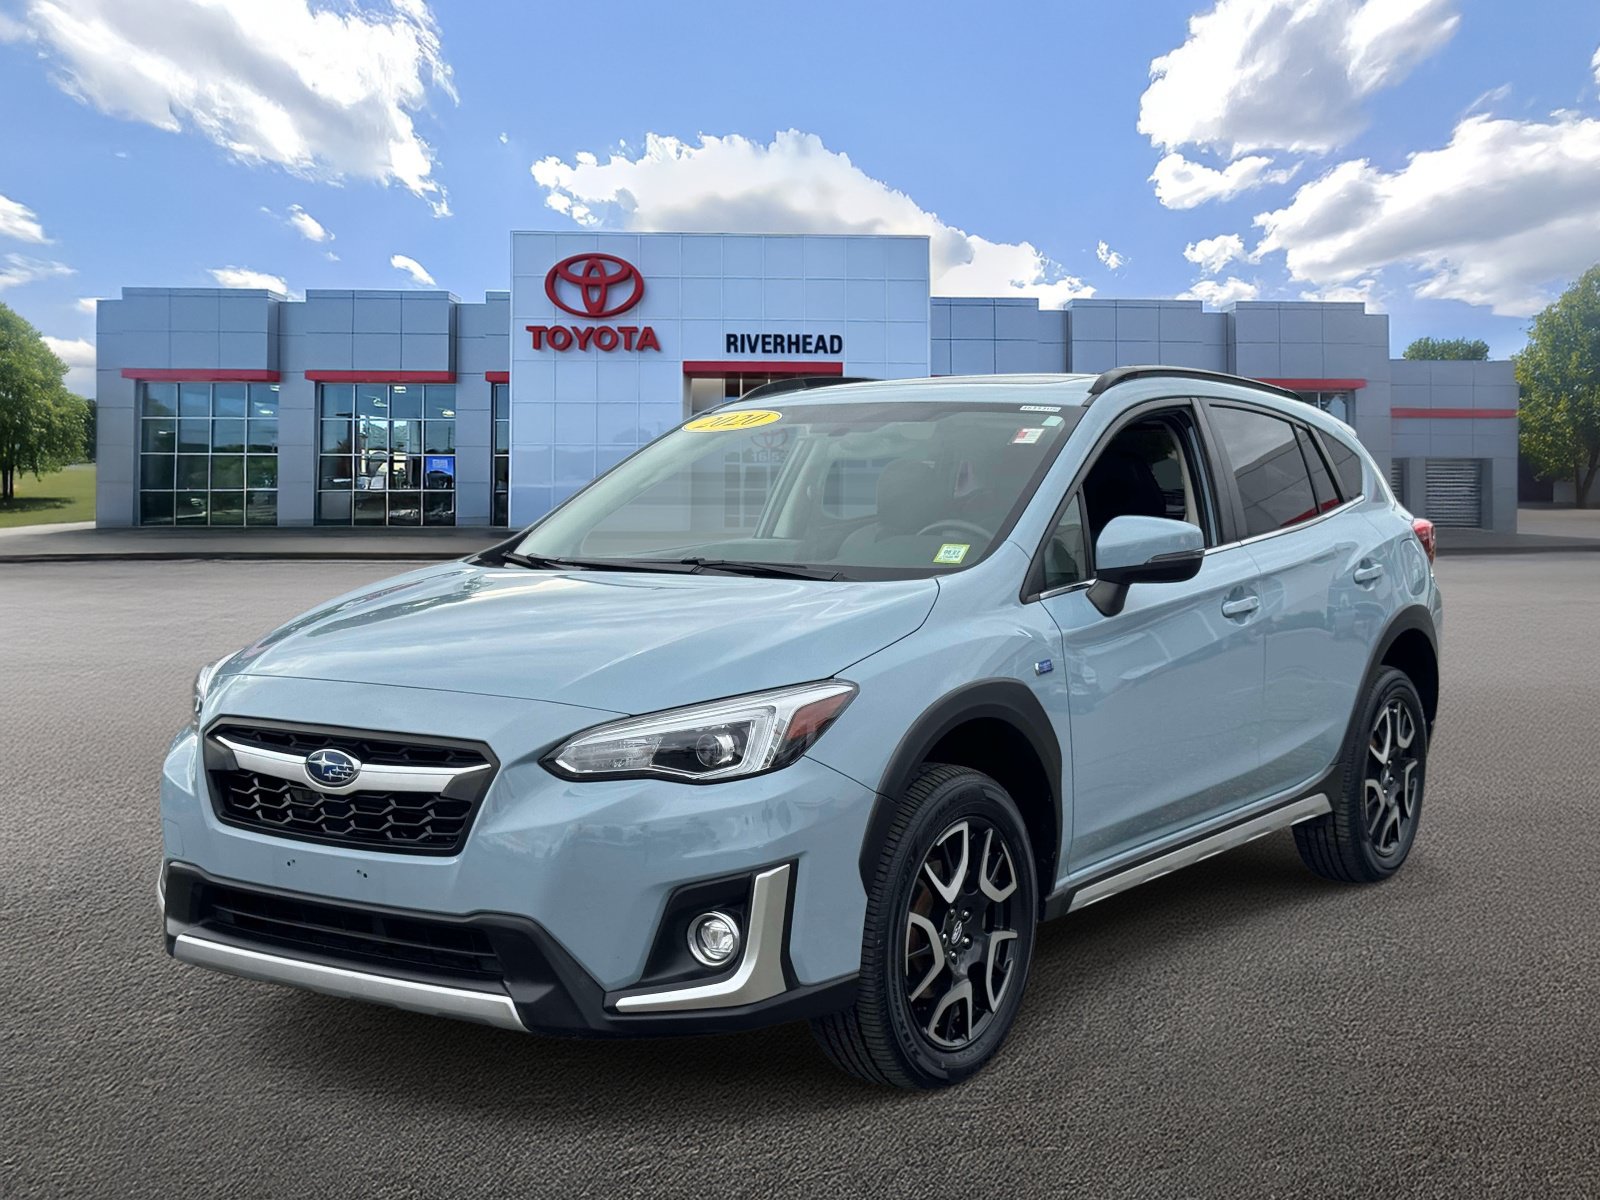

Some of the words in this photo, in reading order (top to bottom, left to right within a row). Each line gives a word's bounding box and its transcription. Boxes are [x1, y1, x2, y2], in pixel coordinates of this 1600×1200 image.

[526, 325, 661, 351] TOYOTA
[726, 333, 843, 354] RIVERHEAD
[692, 413, 771, 428] 2020
